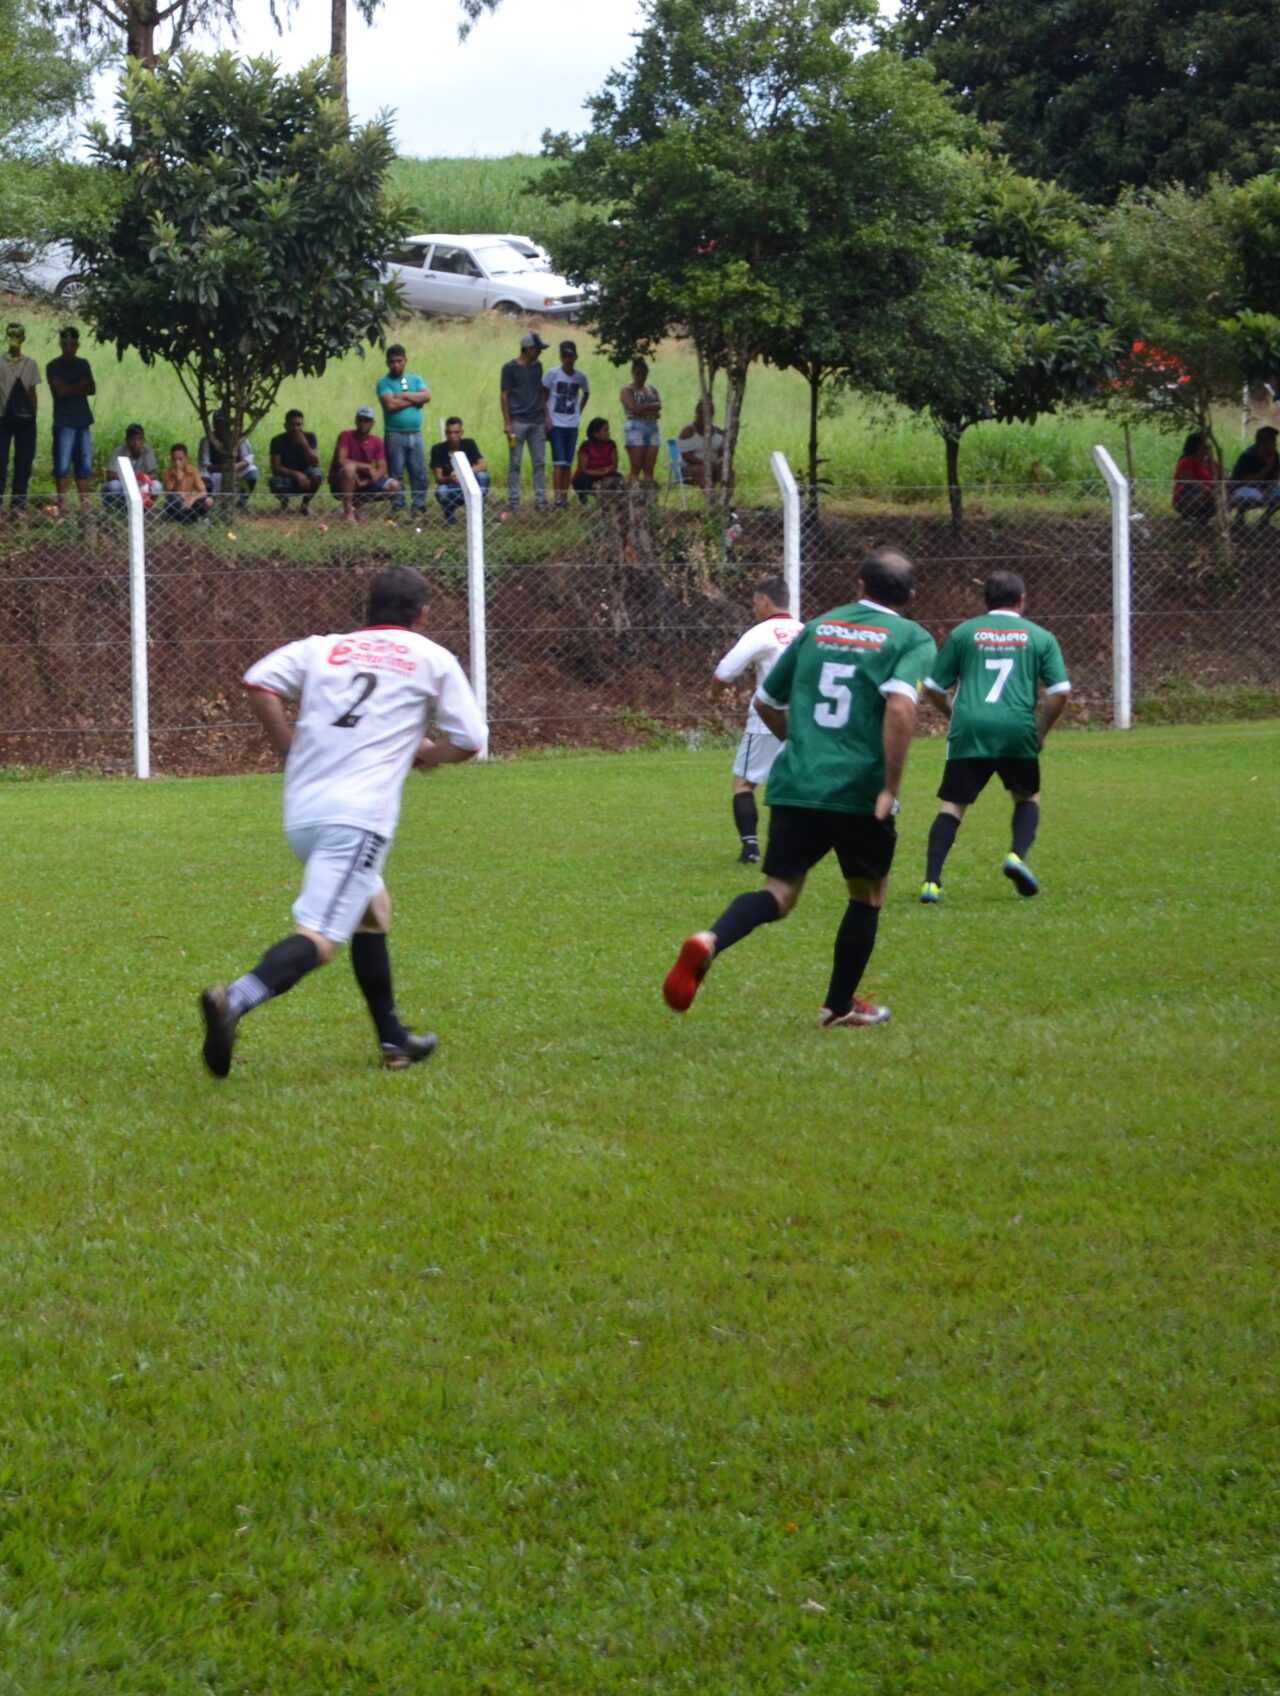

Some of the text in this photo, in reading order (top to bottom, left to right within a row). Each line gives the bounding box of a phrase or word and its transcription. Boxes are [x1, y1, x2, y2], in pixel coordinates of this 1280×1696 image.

[331, 671, 378, 728] 2
[813, 662, 856, 728] 5
[984, 658, 1014, 703] 7
